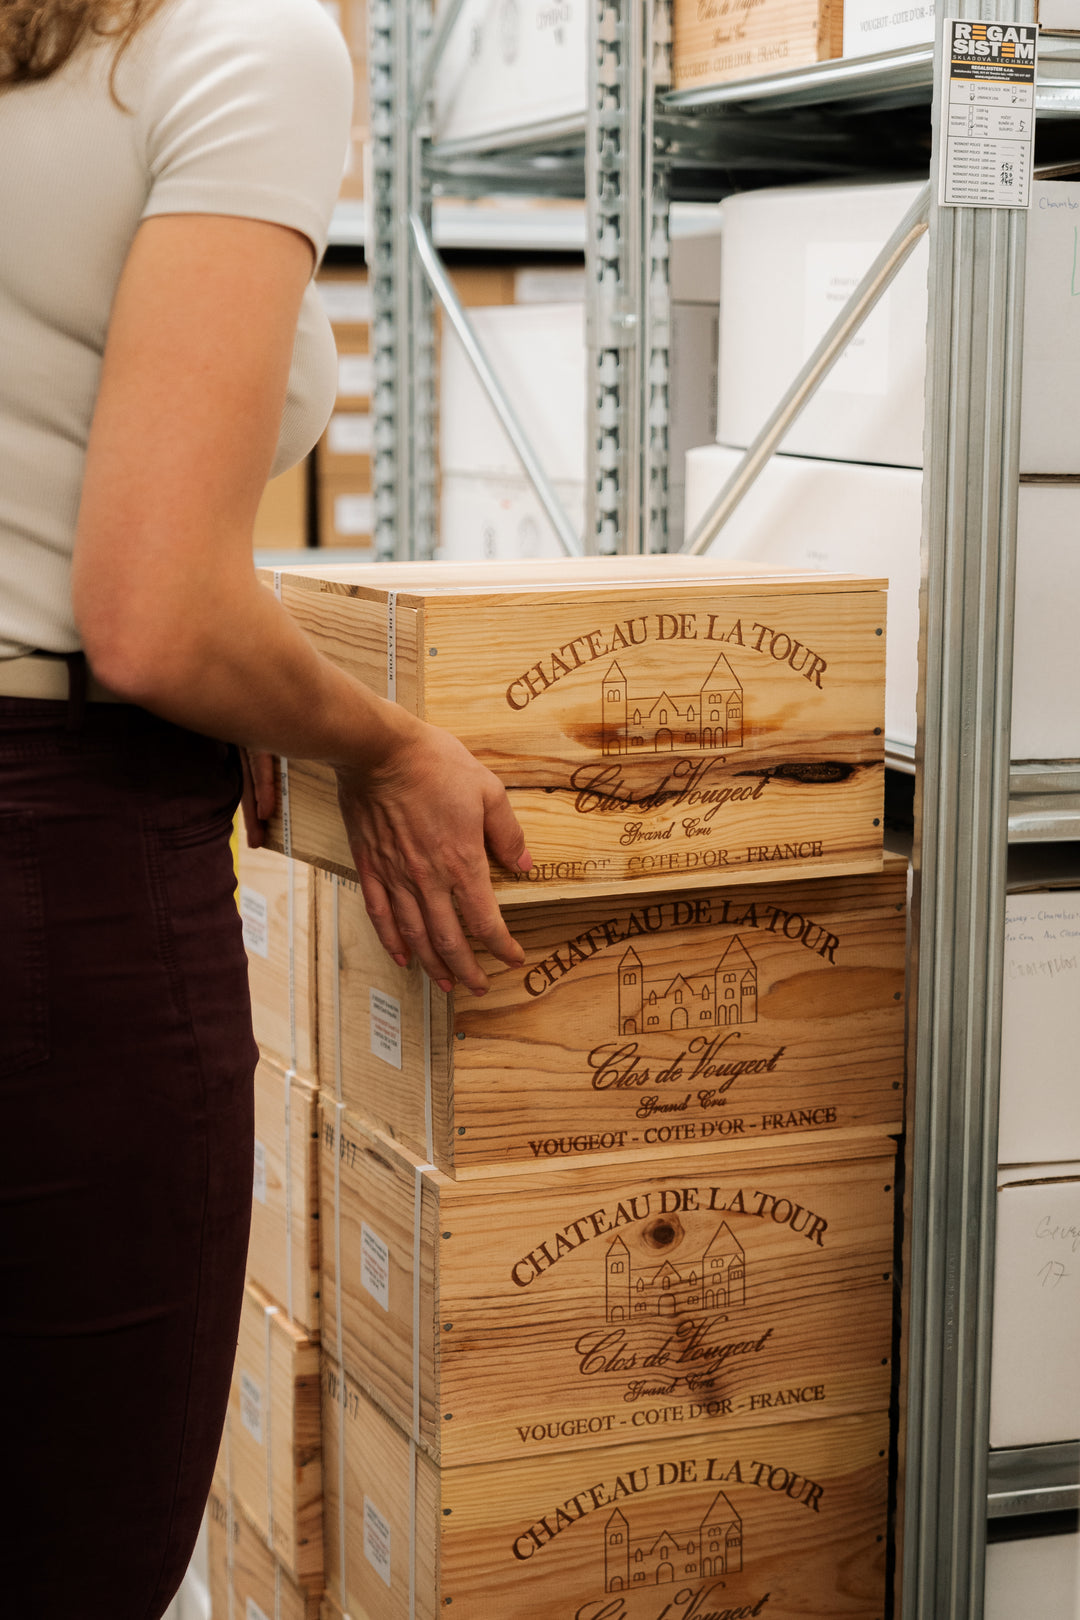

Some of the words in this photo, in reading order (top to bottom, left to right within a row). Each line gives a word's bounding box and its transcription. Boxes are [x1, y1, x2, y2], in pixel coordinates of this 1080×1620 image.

[953, 39, 1034, 59] SISTEM
[955, 23, 1034, 43] REGAL
[505, 616, 649, 711] CHATEAU
[655, 613, 697, 641] DE
[704, 614, 746, 647] LA
[751, 622, 828, 690] TOUR
[570, 763, 636, 814] Clos
[672, 756, 771, 821] Vougeot
[619, 821, 676, 846] Grand
[681, 817, 712, 839] Cru
[627, 851, 681, 873] COTE
[686, 849, 729, 869] D'OR
[746, 840, 824, 863] FRANCE
[524, 905, 664, 998] CHATEAU
[671, 900, 712, 926] DE
[720, 900, 760, 928] LA
[764, 905, 840, 965] TOUR
[587, 1042, 650, 1092] Clos
[655, 1051, 687, 1085] de
[688, 1032, 786, 1094] Vougeot
[528, 1131, 628, 1157] VOUGEOT
[643, 1124, 696, 1144] COTE
[701, 1119, 745, 1138] D'OR
[762, 1107, 837, 1131] FRANCE
[636, 1094, 691, 1119] Grand
[697, 1090, 728, 1109] Cru
[511, 1193, 651, 1288] CHATEAU
[658, 1188, 700, 1214] DE
[706, 1187, 748, 1214] LA
[752, 1191, 829, 1247] TOUR
[575, 1329, 637, 1376] Clos
[642, 1336, 675, 1368] de
[675, 1315, 775, 1376] Vougeot
[516, 1415, 616, 1443] VOUGEOT
[631, 1406, 684, 1427] COTE
[689, 1398, 733, 1419] D'OR
[750, 1385, 826, 1411] FRANCE
[623, 1379, 679, 1402] Grand
[684, 1373, 716, 1392] Cru
[511, 1466, 650, 1561] CHATEAU
[656, 1459, 697, 1486] DE
[703, 1458, 745, 1484] LA
[748, 1460, 824, 1513] TOUR
